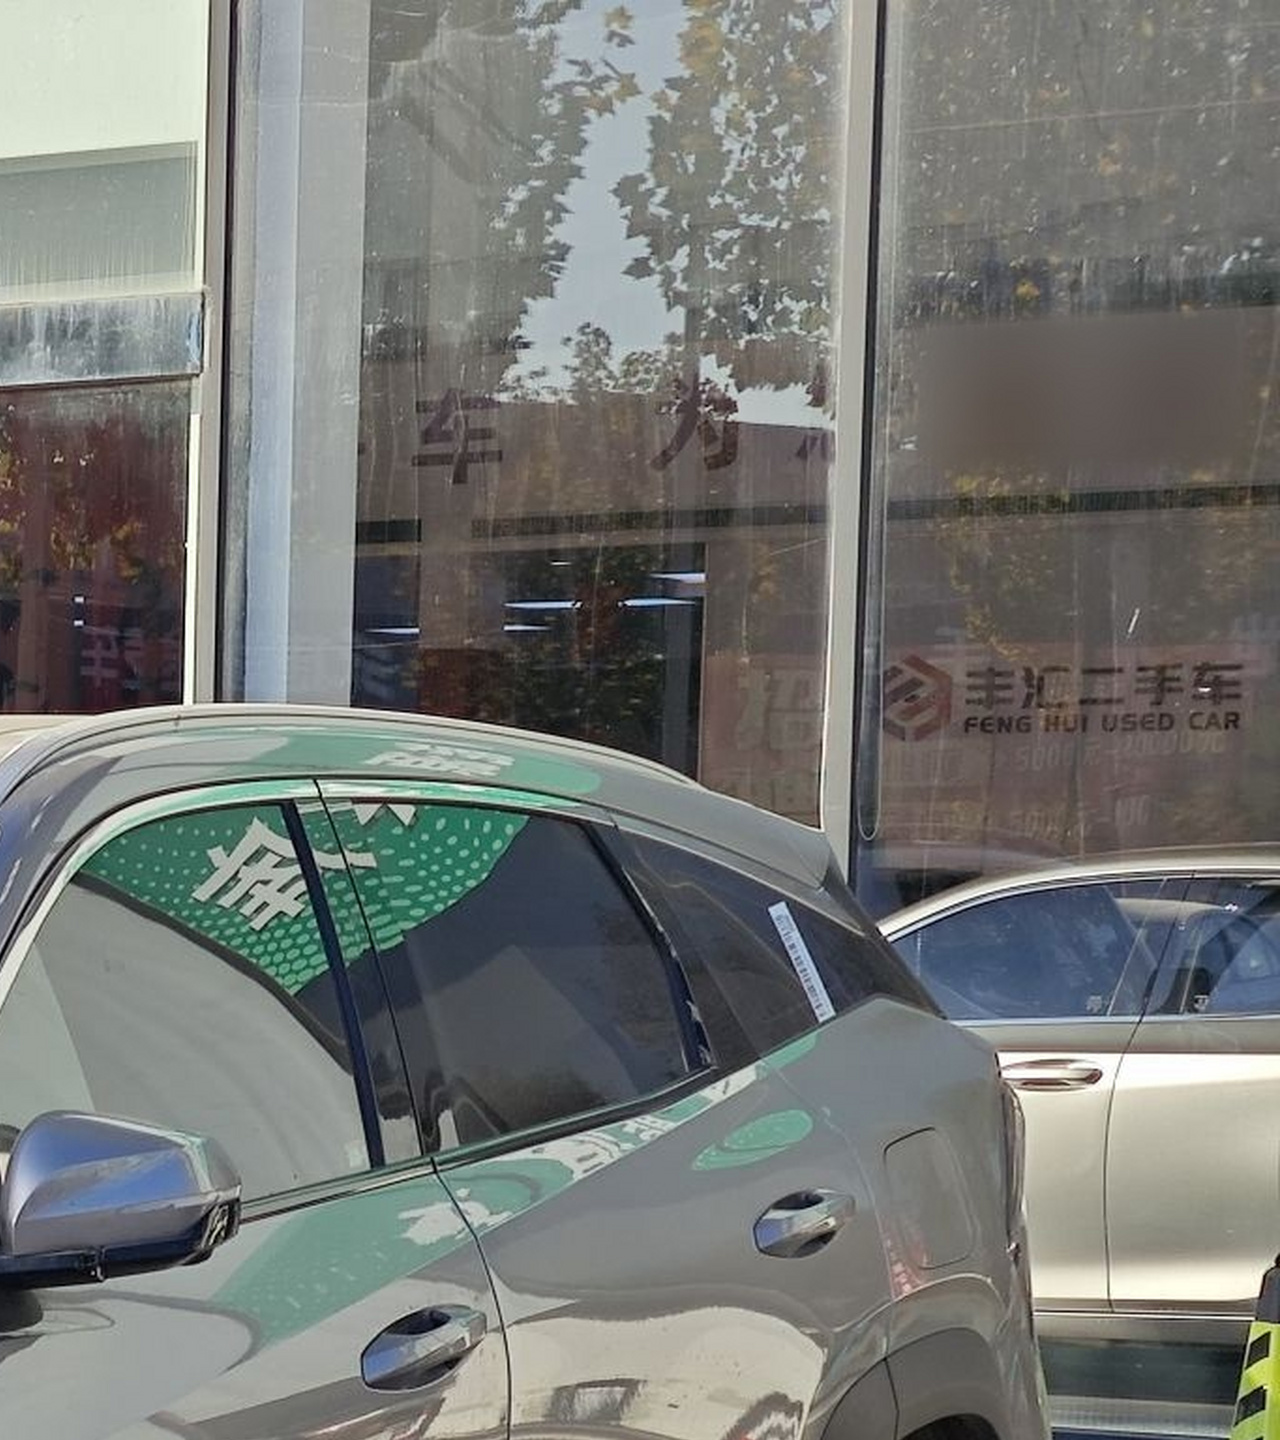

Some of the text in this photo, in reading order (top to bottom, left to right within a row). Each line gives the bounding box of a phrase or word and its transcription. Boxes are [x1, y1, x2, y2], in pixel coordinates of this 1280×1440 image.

[964, 712, 1241, 734] FENG HUI USED CAR
